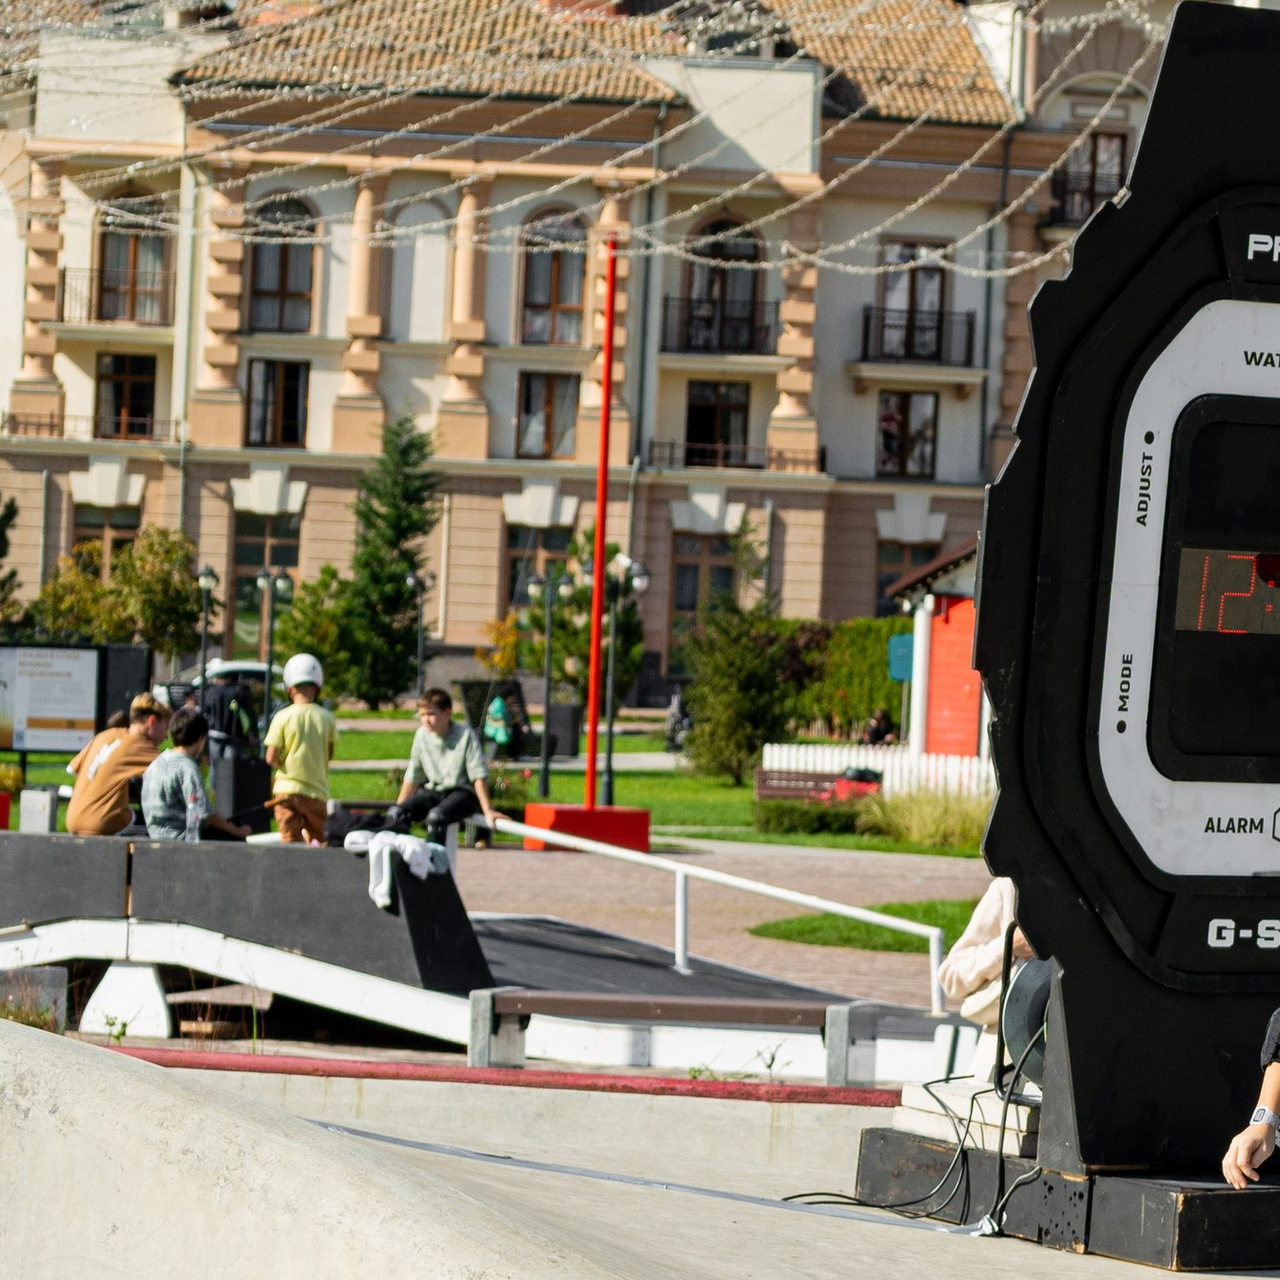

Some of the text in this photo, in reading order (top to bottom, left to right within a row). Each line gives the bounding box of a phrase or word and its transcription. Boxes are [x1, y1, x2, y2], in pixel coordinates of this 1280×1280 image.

[1136, 451, 1153, 527] ADJUST
[1117, 653, 1133, 712] MODE
[1204, 817, 1264, 834] ALARM
